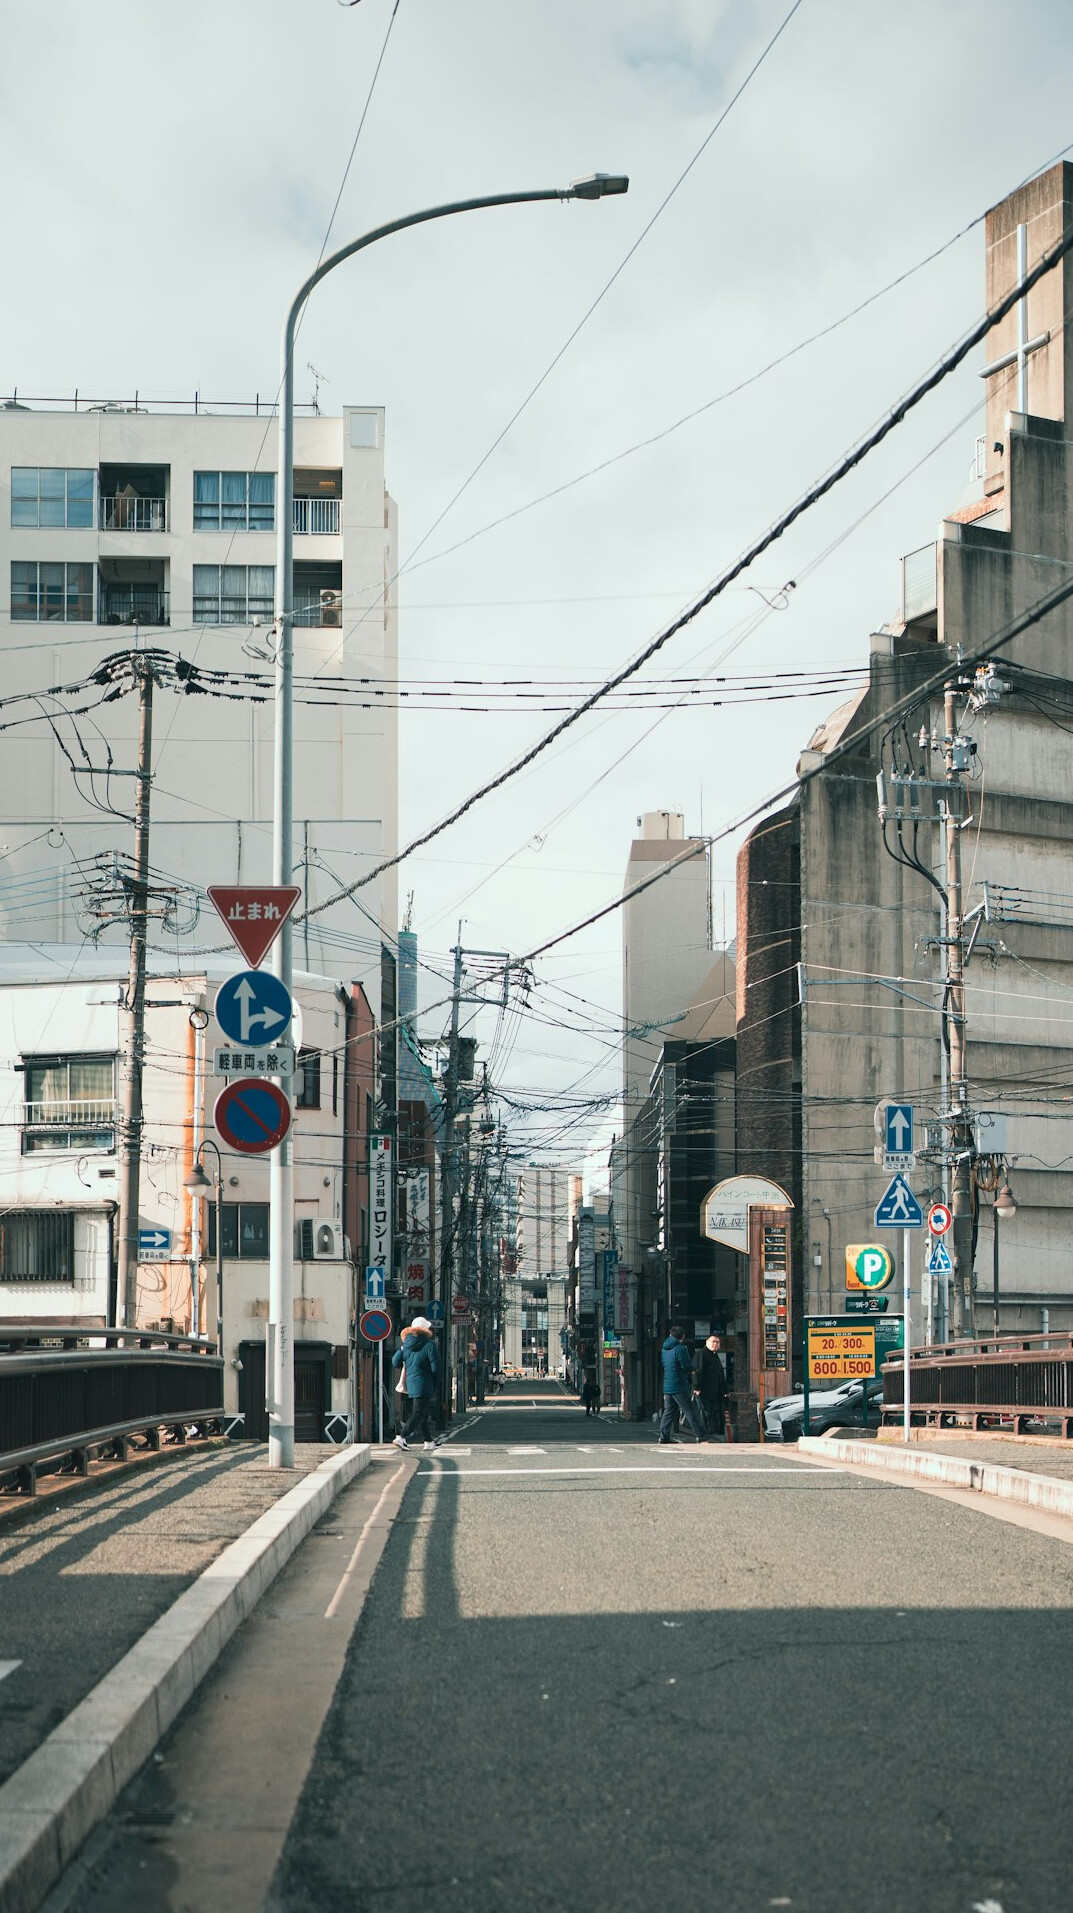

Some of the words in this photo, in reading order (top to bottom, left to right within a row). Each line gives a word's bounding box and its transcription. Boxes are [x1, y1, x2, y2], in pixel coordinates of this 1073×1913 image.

[227, 901, 282, 922] 止まれ
[218, 1053, 288, 1072] 軽車両を除く
[375, 1152, 386, 1207] メキシコ料理
[709, 1217, 746, 1228] NAKASU
[373, 1210, 388, 1267] ロシータ
[864, 1253, 882, 1282] P
[407, 1263, 426, 1302] 焼肉
